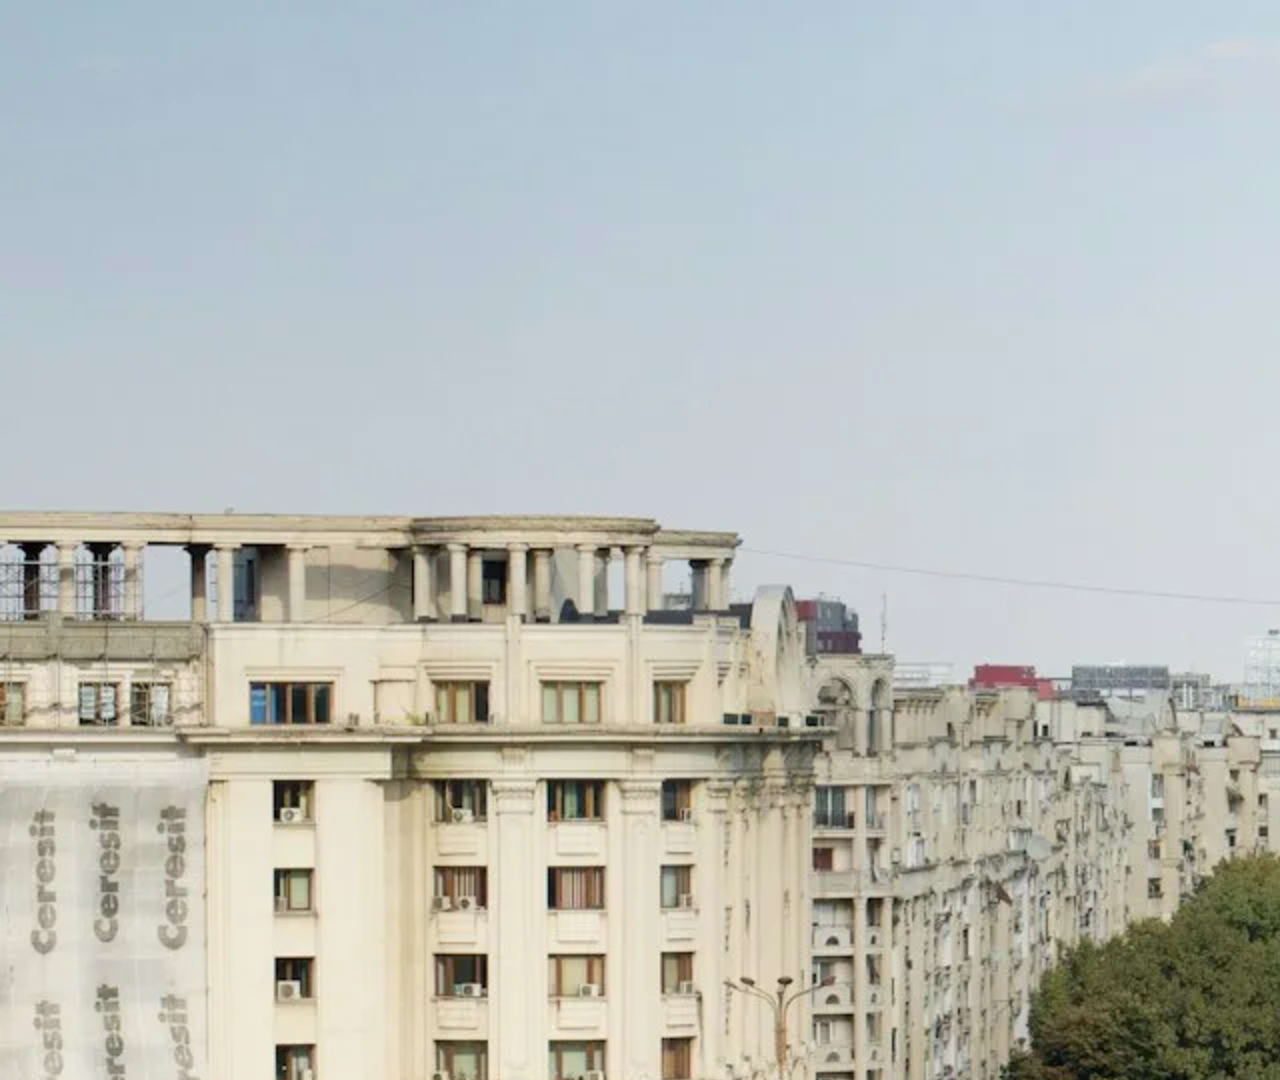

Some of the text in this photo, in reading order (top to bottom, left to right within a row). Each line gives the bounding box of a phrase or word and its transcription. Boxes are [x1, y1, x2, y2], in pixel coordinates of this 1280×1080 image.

[29, 807, 57, 955] Ceresit
[89, 801, 120, 943] Ceresit
[157, 805, 188, 951] Ceresit
